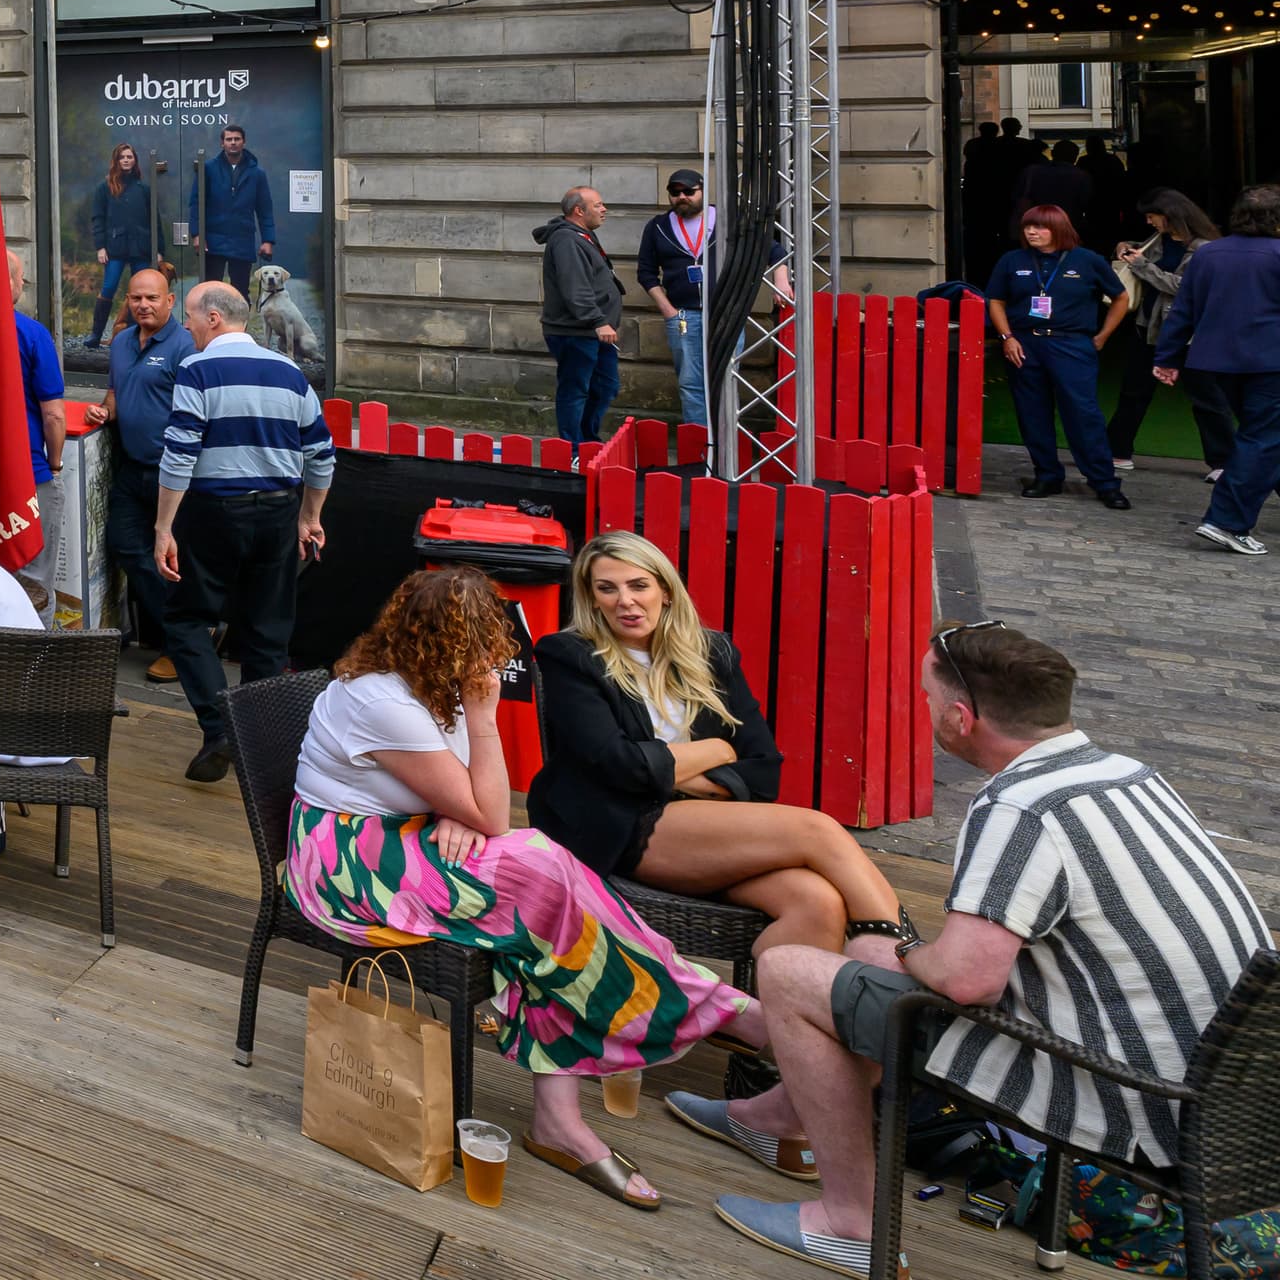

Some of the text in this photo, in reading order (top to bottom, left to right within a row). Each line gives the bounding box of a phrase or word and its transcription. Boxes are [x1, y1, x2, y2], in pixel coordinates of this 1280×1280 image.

[104, 73, 226, 108] dubarry
[162, 99, 211, 108] of Ireland
[104, 113, 229, 127] COMING SOON
[330, 1042, 393, 1088] Cloud 9
[325, 1060, 396, 1111] Edinburgh
